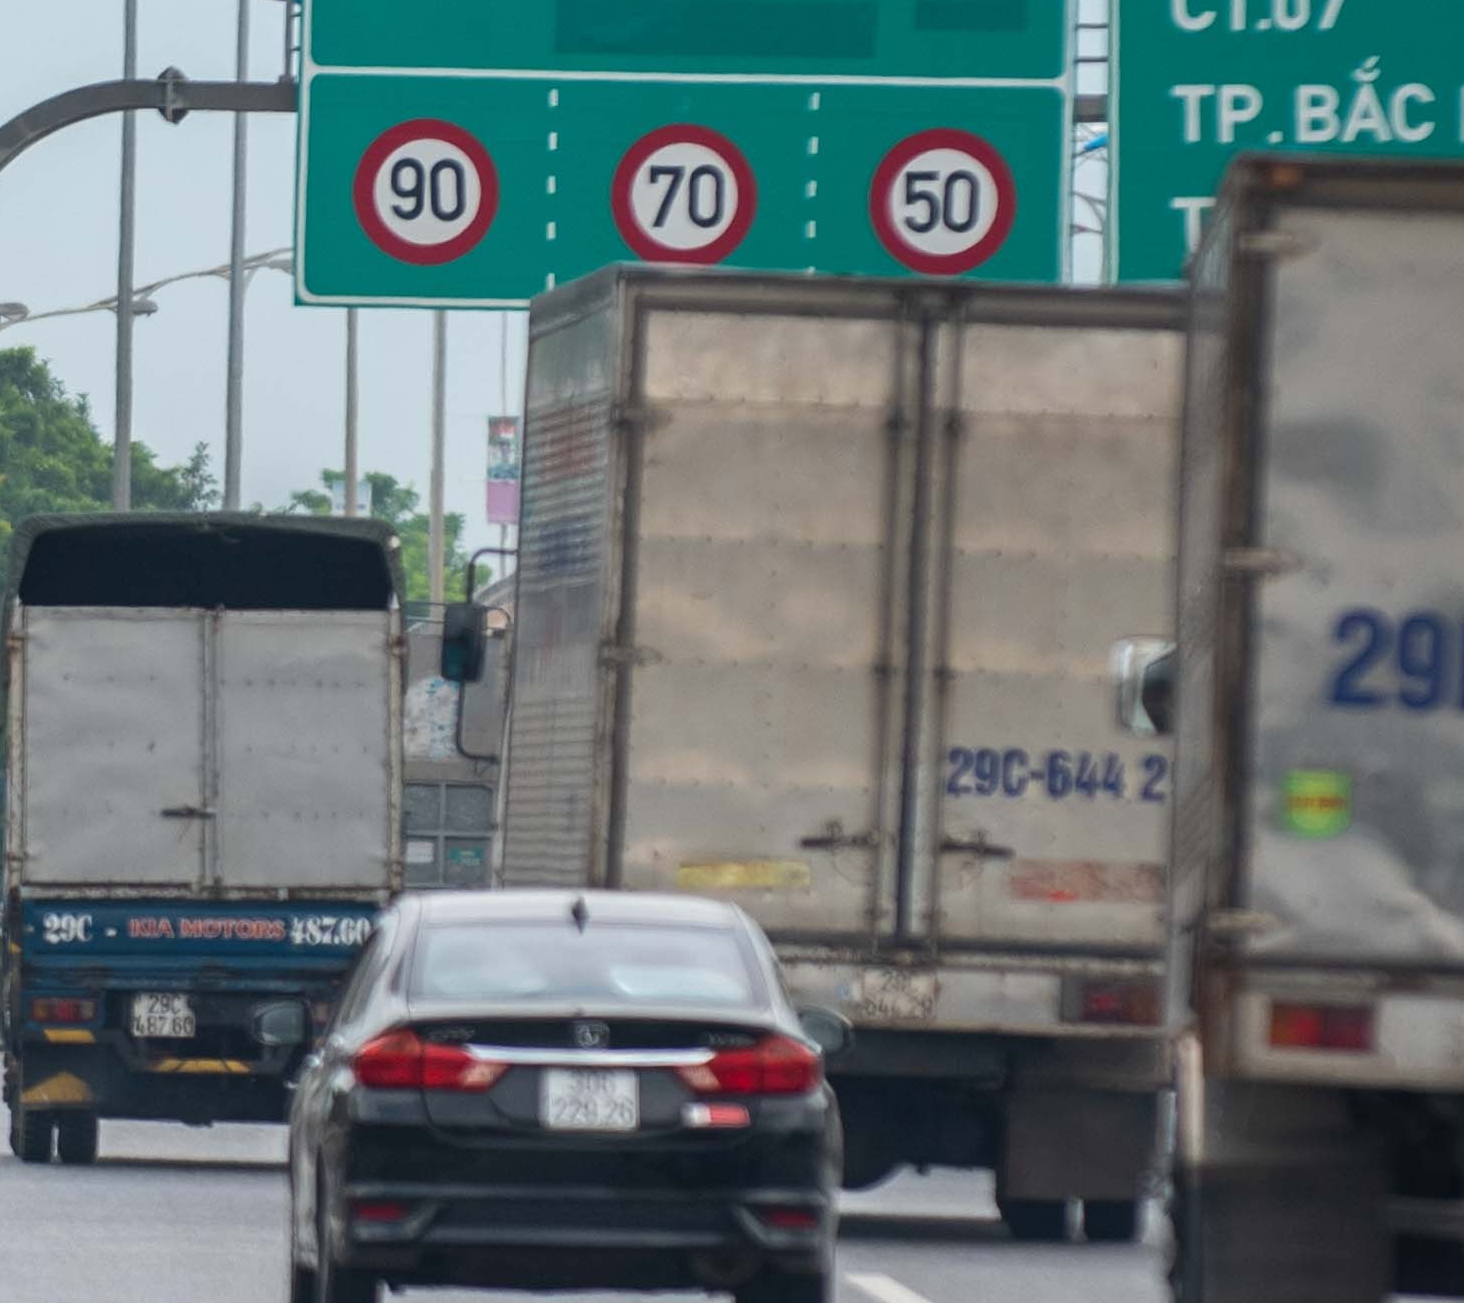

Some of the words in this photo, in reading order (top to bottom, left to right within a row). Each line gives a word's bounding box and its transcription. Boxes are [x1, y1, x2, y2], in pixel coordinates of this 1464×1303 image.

[390, 157, 467, 222] 90
[647, 163, 728, 229] 70
[902, 169, 981, 235] 50
[43, 913, 94, 944] 29C
[128, 916, 174, 939] KIA
[179, 916, 287, 941] MOTORS
